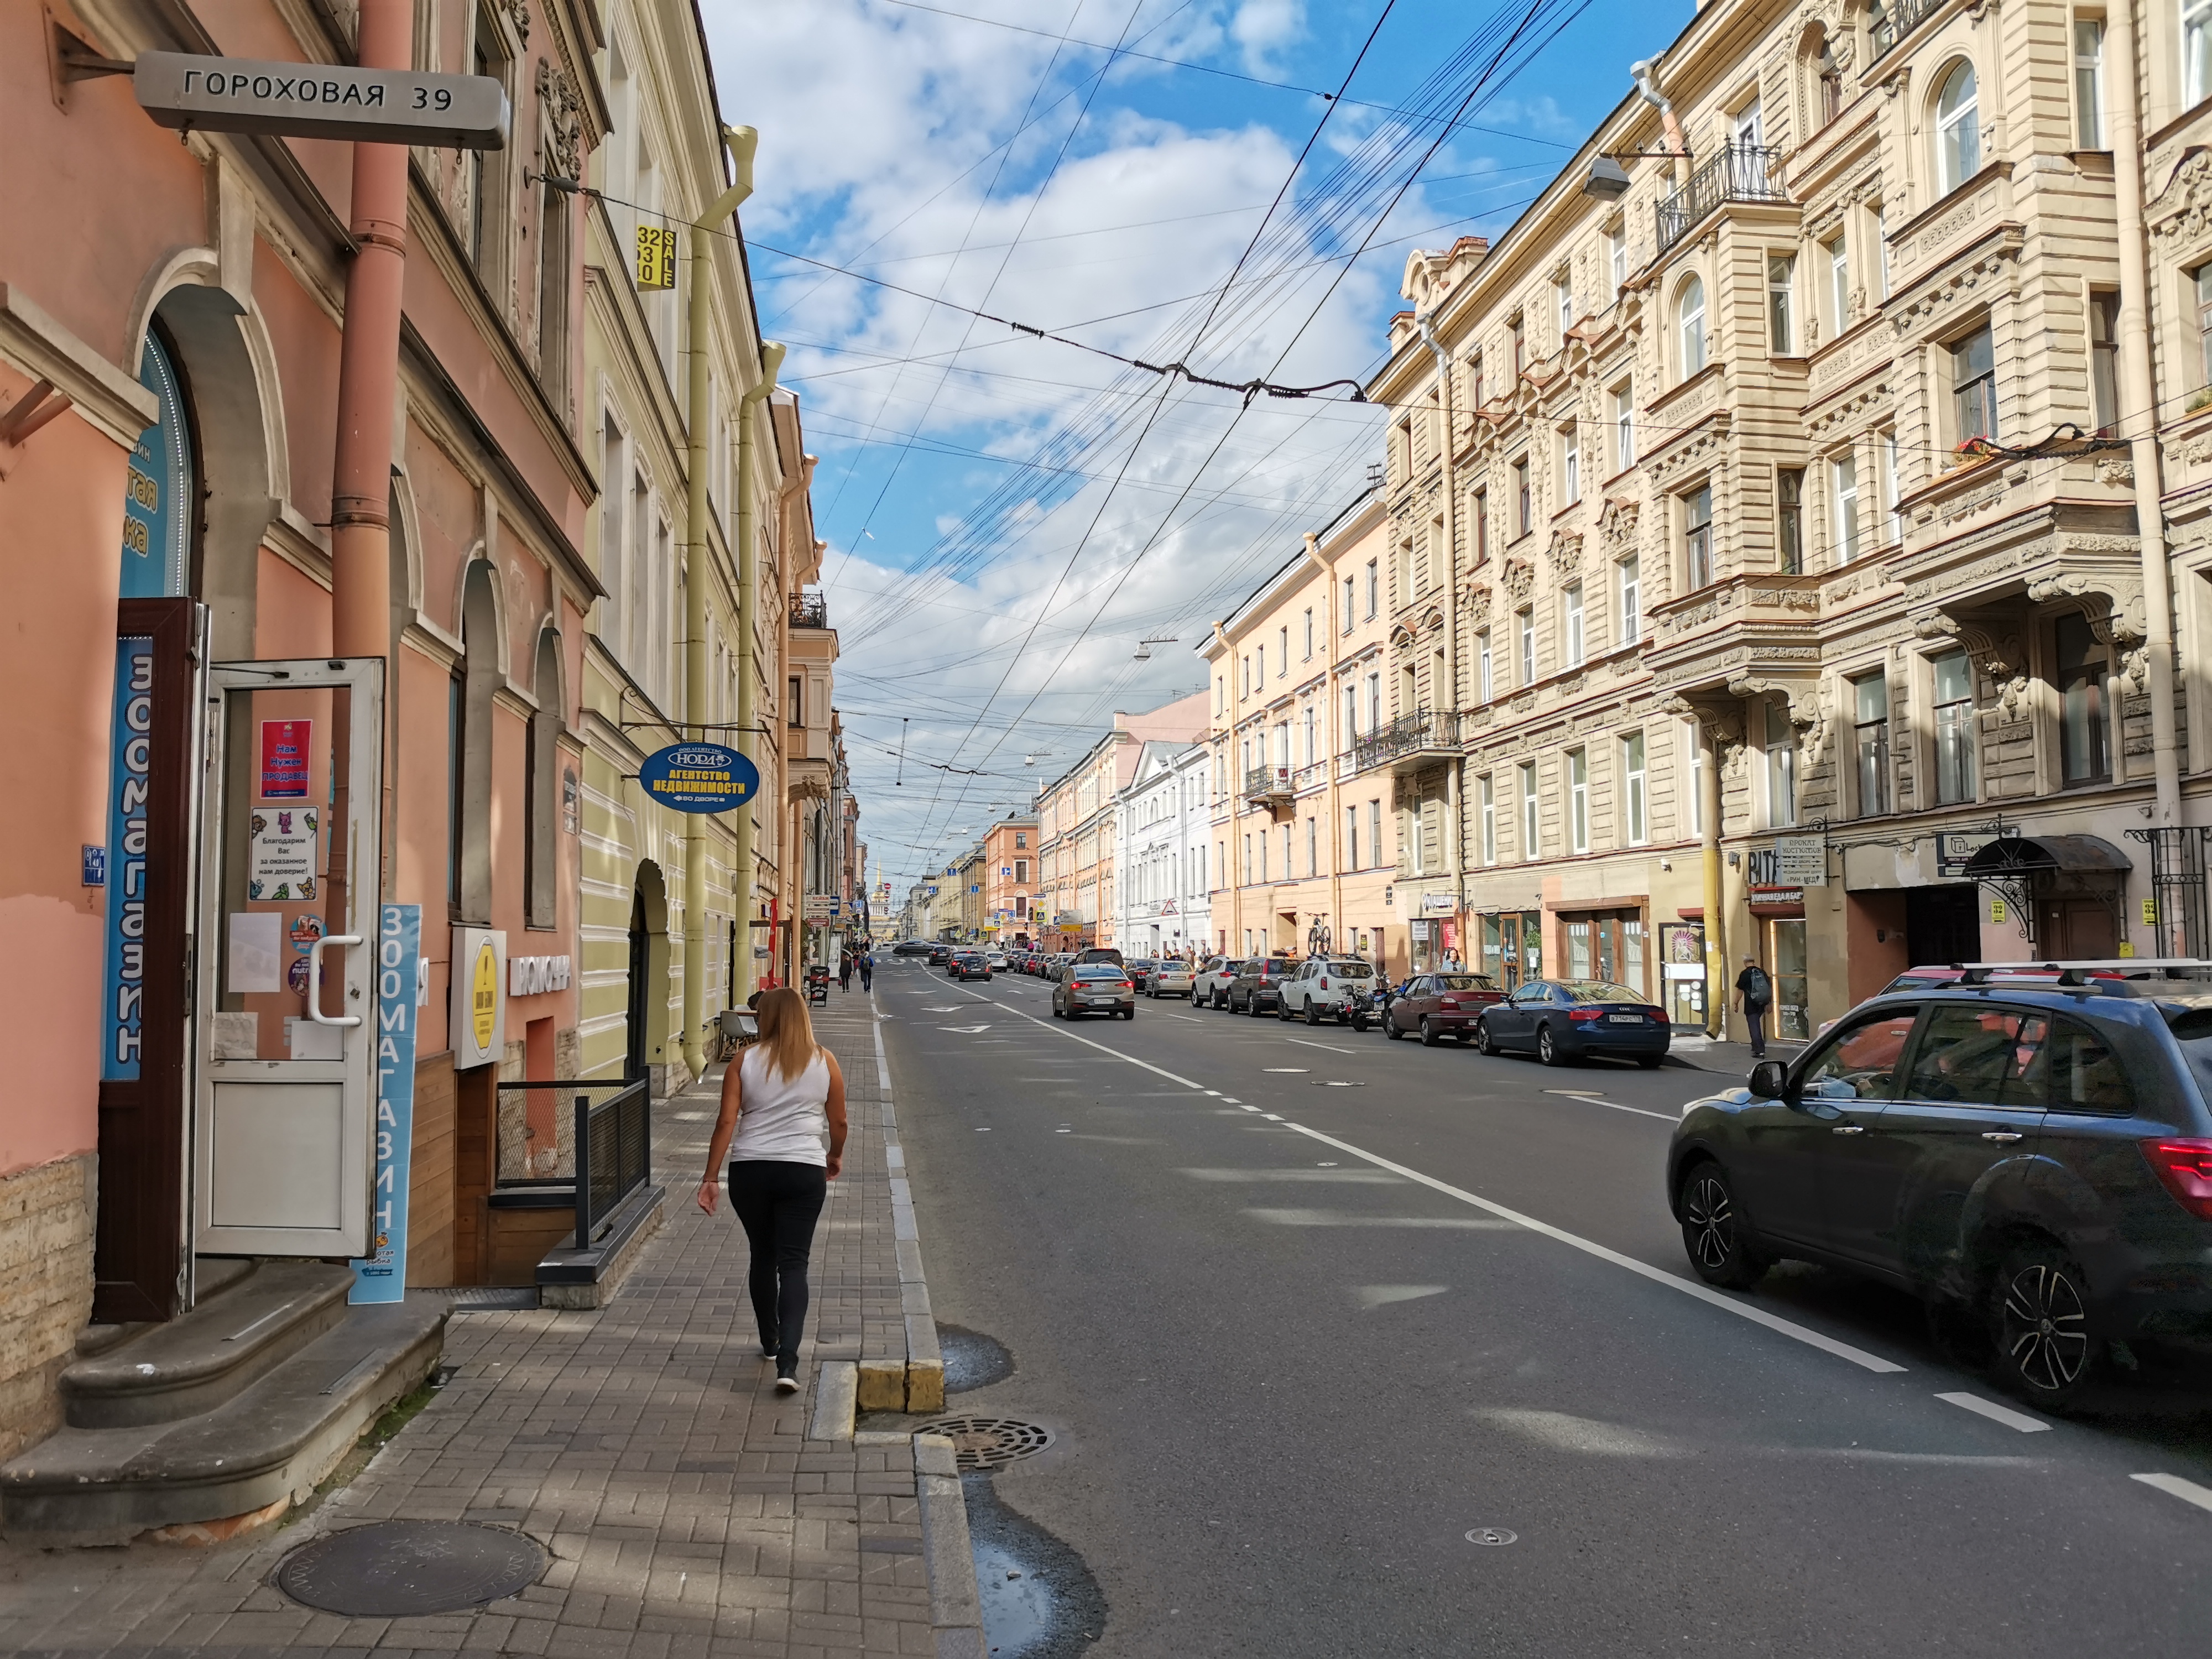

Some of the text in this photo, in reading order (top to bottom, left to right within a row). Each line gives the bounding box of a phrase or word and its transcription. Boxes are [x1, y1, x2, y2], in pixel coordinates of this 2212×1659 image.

[184, 69, 452, 112] ГОРОХОВАЯ 39
[663, 231, 674, 287] SALE
[637, 263, 653, 281] 0
[276, 744, 298, 754] Нам
[270, 757, 302, 769] Нужен
[676, 754, 716, 766] НОРД
[262, 771, 308, 782] ПРОДАВЕЦ
[669, 769, 731, 781] АГЕНТСТВО
[653, 780, 745, 794] НЕДВИЖИМОСТИ
[262, 837, 306, 846] Благодарим
[274, 867, 308, 875] доверие!
[1993, 905, 2002, 914] 32
[377, 907, 405, 1229] ЗООМАГАЗИН
